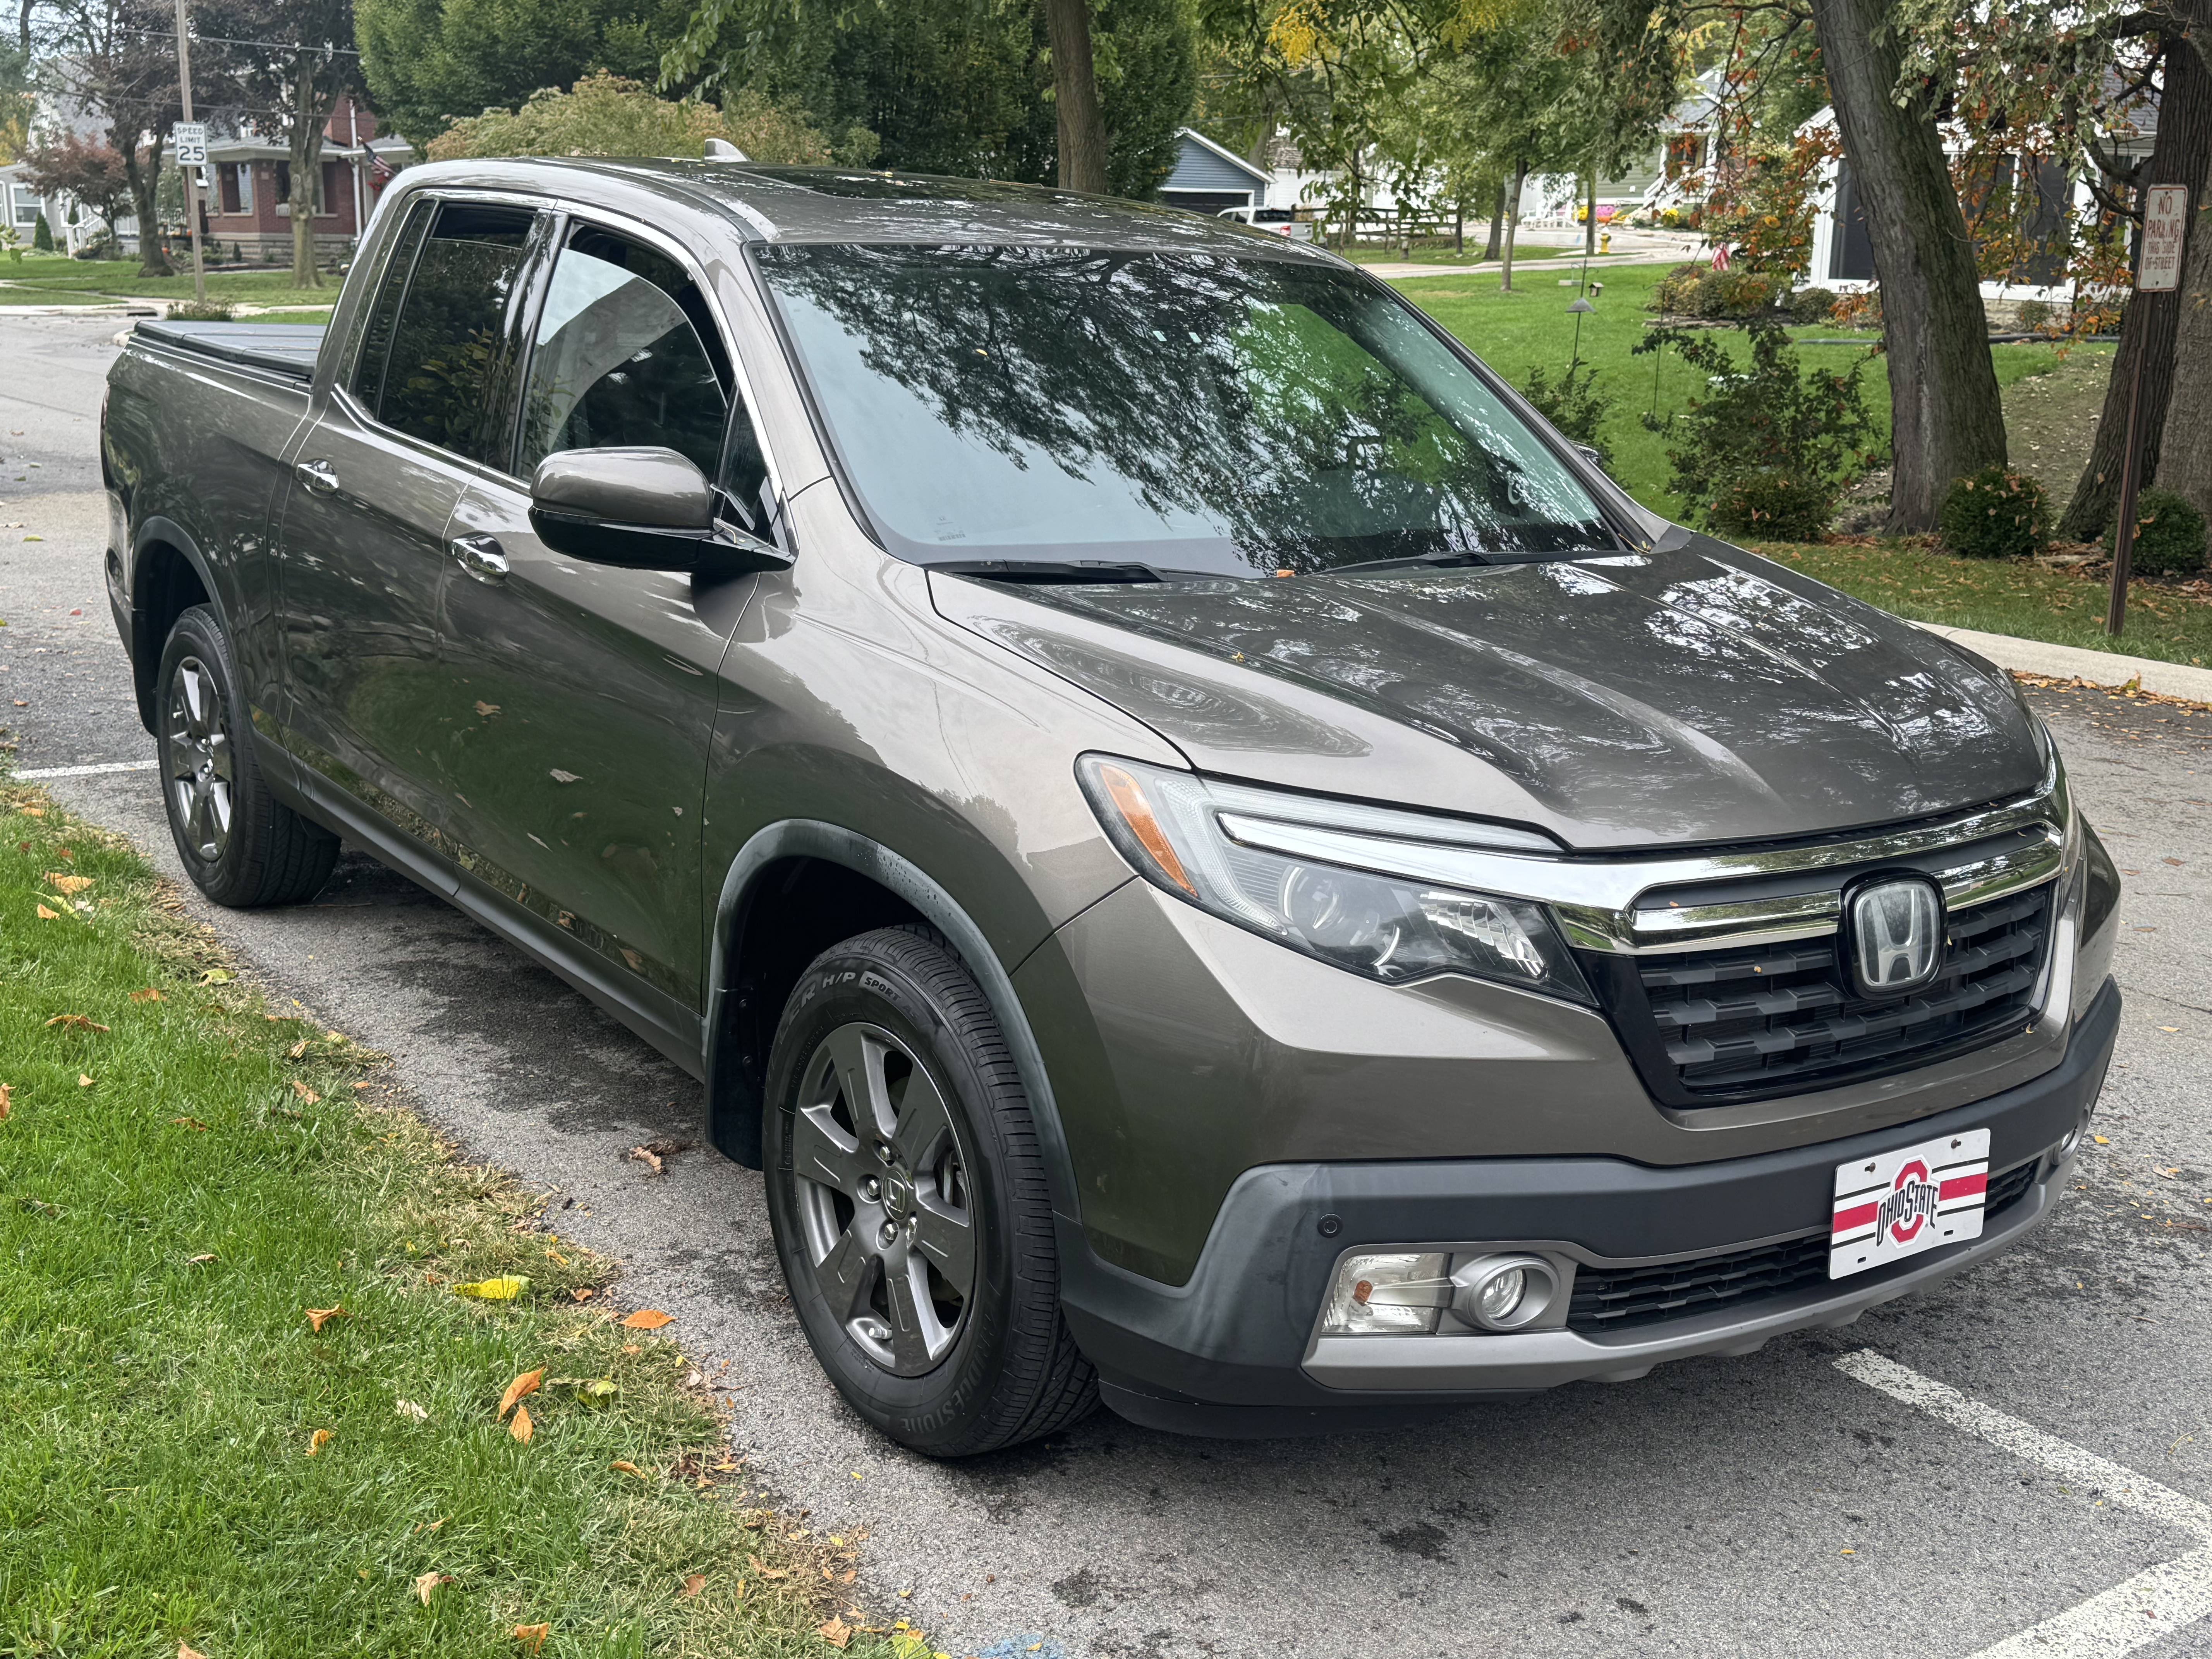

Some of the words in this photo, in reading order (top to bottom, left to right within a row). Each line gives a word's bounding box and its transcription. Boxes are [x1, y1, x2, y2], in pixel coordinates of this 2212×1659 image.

[179, 146, 204, 161] 25
[2158, 196, 2172, 214] NO
[2148, 241, 2160, 254] THIS
[2162, 241, 2175, 254] SIDE
[822, 972, 856, 989] H/P
[864, 977, 902, 1001] SPORT
